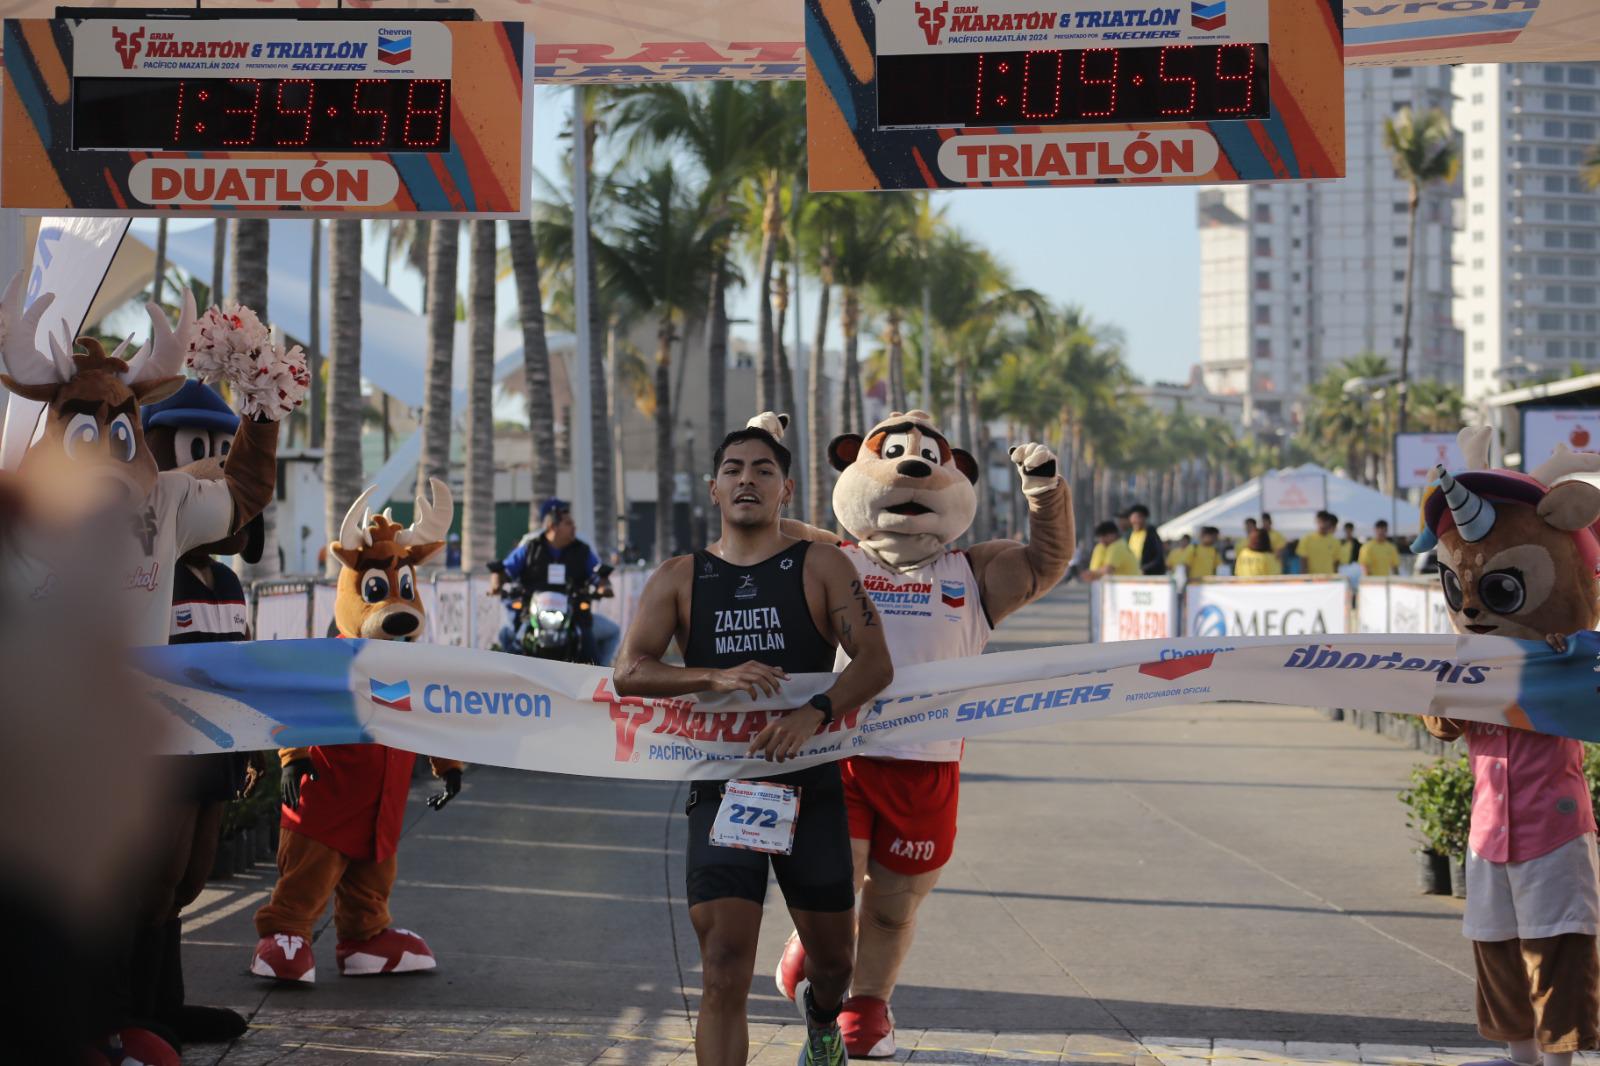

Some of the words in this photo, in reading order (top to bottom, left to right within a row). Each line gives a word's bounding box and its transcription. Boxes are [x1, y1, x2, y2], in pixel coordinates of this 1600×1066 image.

[949, 11, 1057, 32] MARATÓN
[1059, 13, 1071, 28] &
[1074, 8, 1181, 28] TRIATLÓN
[953, 6, 979, 14] GRAN
[378, 28, 412, 36] Chevron
[948, 34, 983, 44] PACÍFICO
[985, 33, 1027, 43] MAZATLÁN
[1101, 30, 1181, 41] SKECHERS
[145, 40, 250, 58] MARATÓN
[251, 43, 263, 58] &
[266, 41, 368, 59] TRIATLÓN
[143, 60, 178, 69] PACÍFICO
[179, 61, 220, 69] MAZATLÁN
[291, 63, 368, 71] SKECHERS
[956, 132, 1194, 180] TRIATLÓN
[151, 161, 369, 202] DUATLÓN
[714, 606, 782, 633] ZAZUETA
[715, 630, 785, 655] MAZATLÁN
[423, 683, 551, 718] Chevron
[927, 708, 949, 721] POR
[956, 683, 1114, 722] SKECHERS
[1125, 688, 1182, 702] PATROCINADOR
[1182, 685, 1213, 696] OFICIAL
[729, 803, 778, 829] 272
[889, 837, 935, 861] KATO
